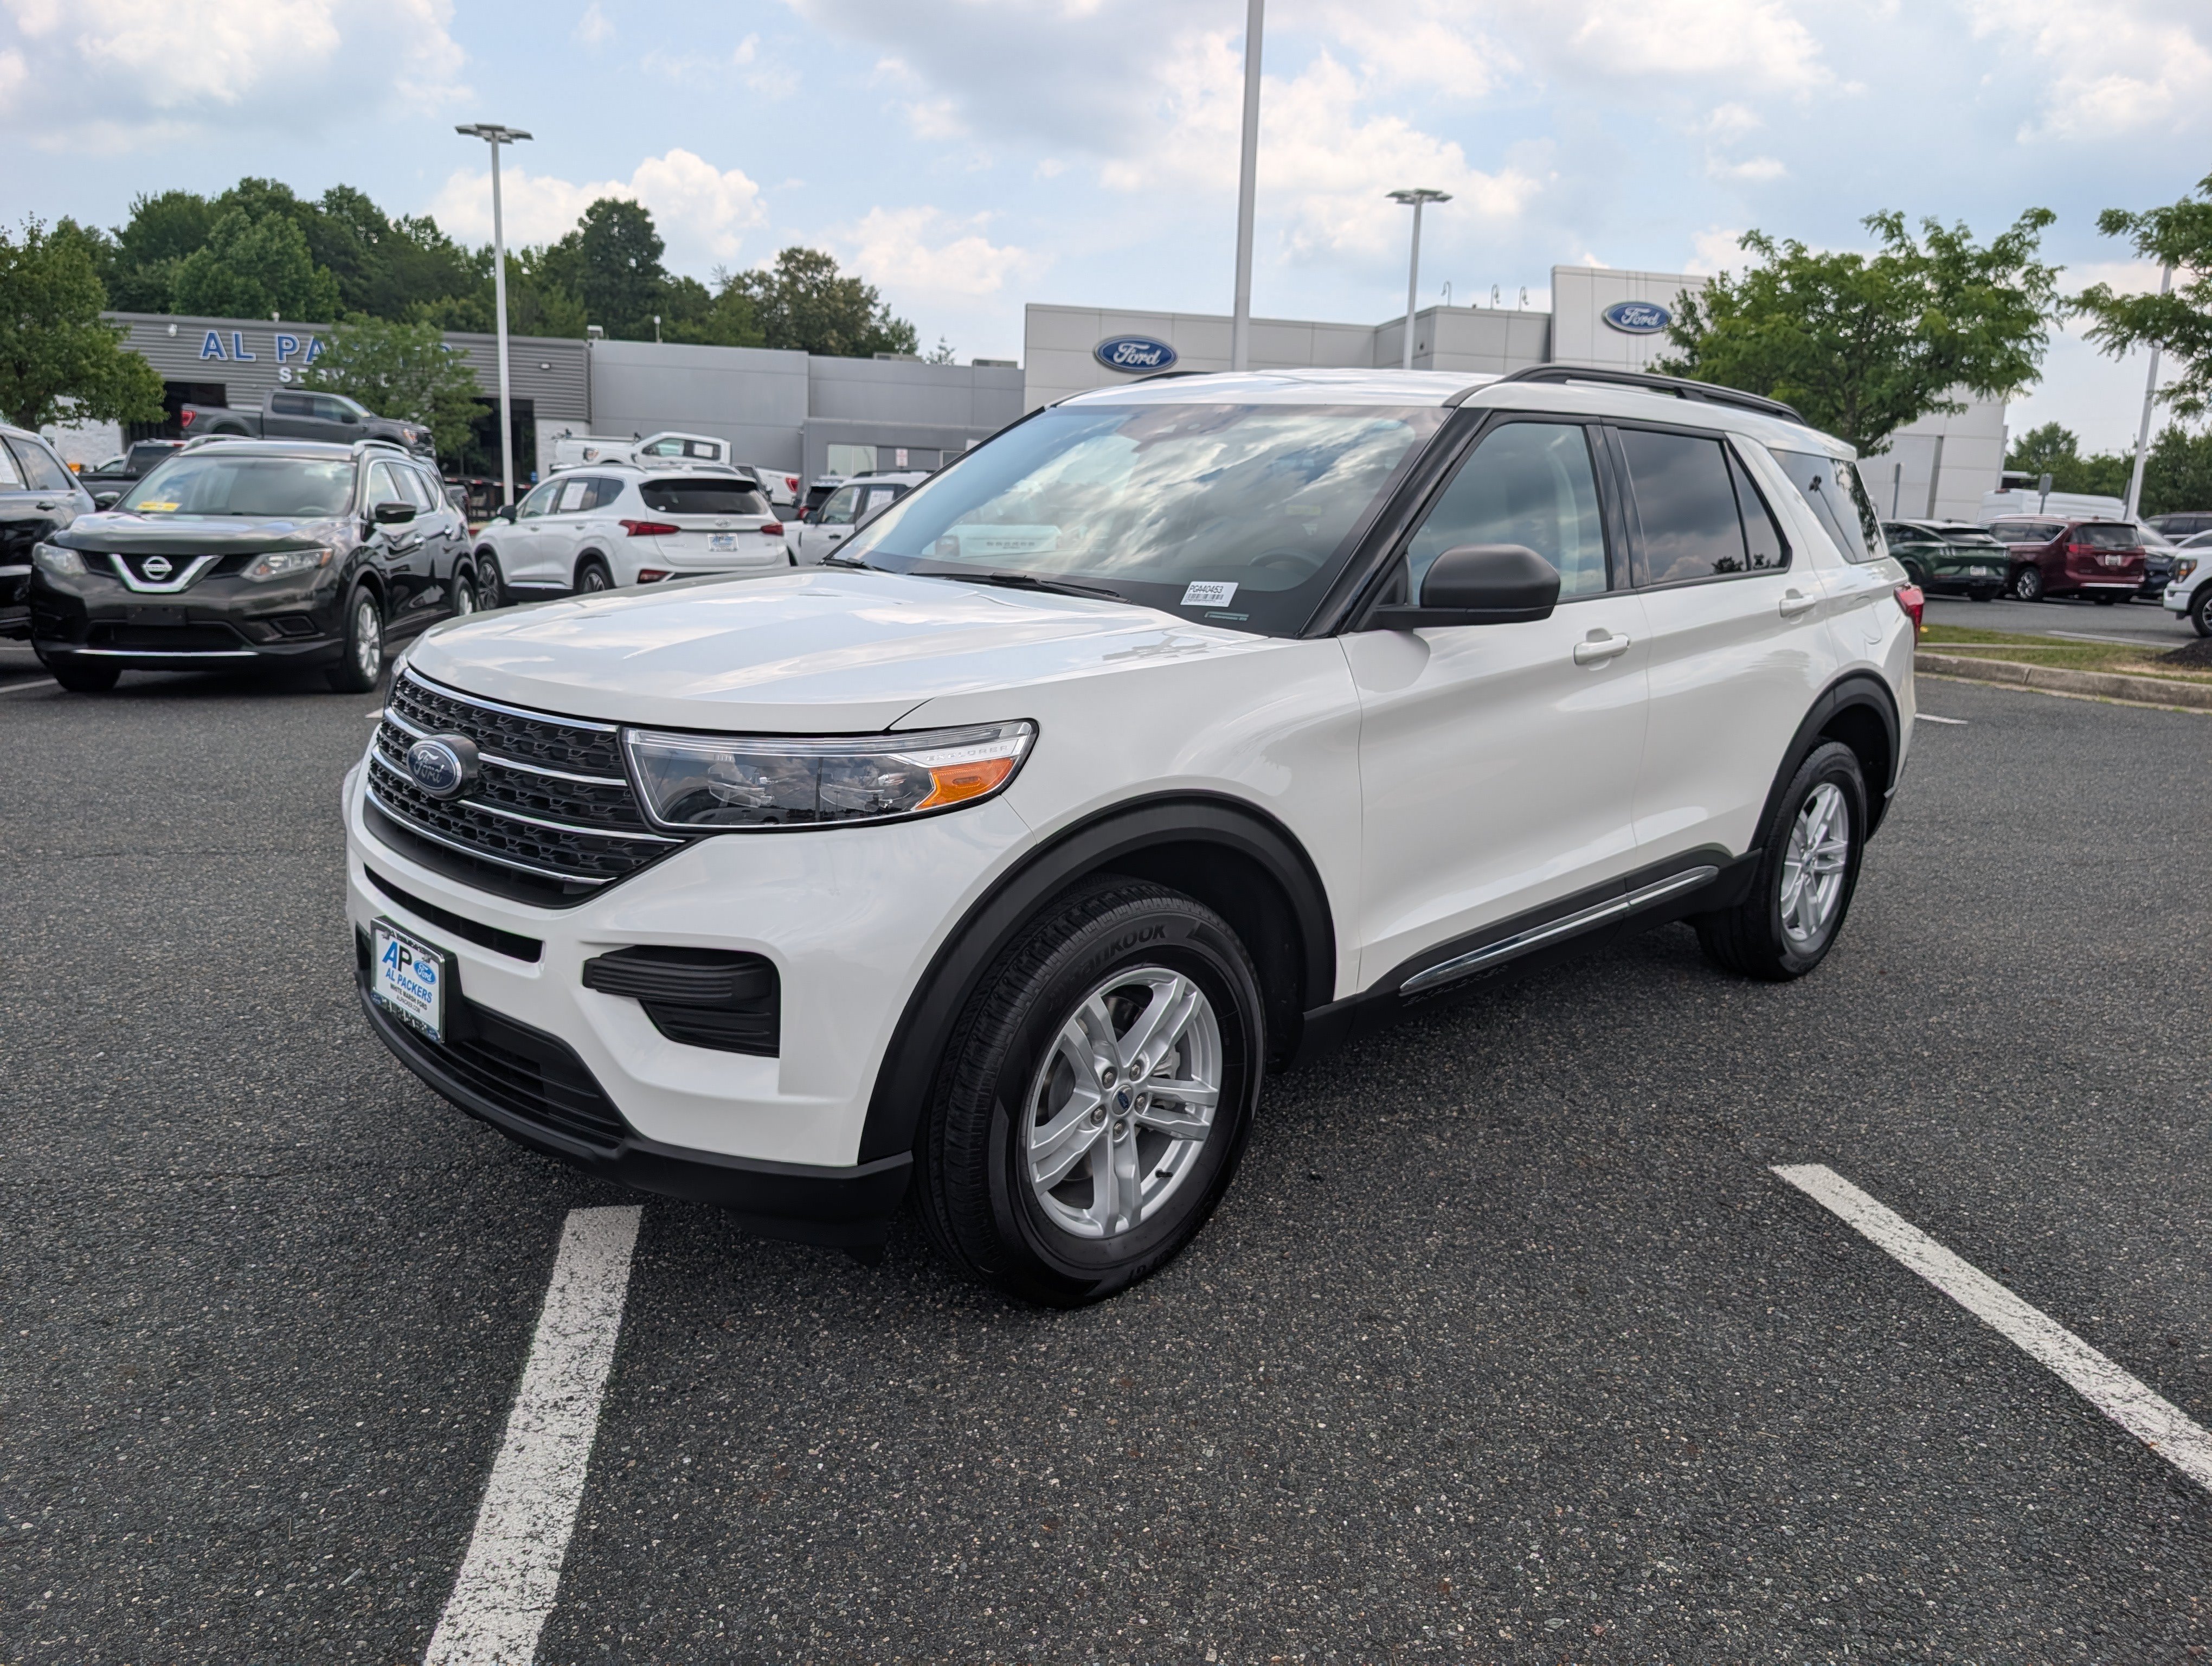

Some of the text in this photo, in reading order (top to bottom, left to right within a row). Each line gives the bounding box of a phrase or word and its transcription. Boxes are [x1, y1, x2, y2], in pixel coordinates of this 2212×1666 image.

[1621, 306, 1661, 326] Ford
[199, 329, 257, 362] AL
[1113, 342, 1162, 366] Ford
[413, 749, 445, 784] Ford
[926, 745, 1008, 761] EXPLORER
[382, 940, 413, 972] AP
[385, 967, 396, 982] AL
[397, 973, 433, 1003] PACKERS
